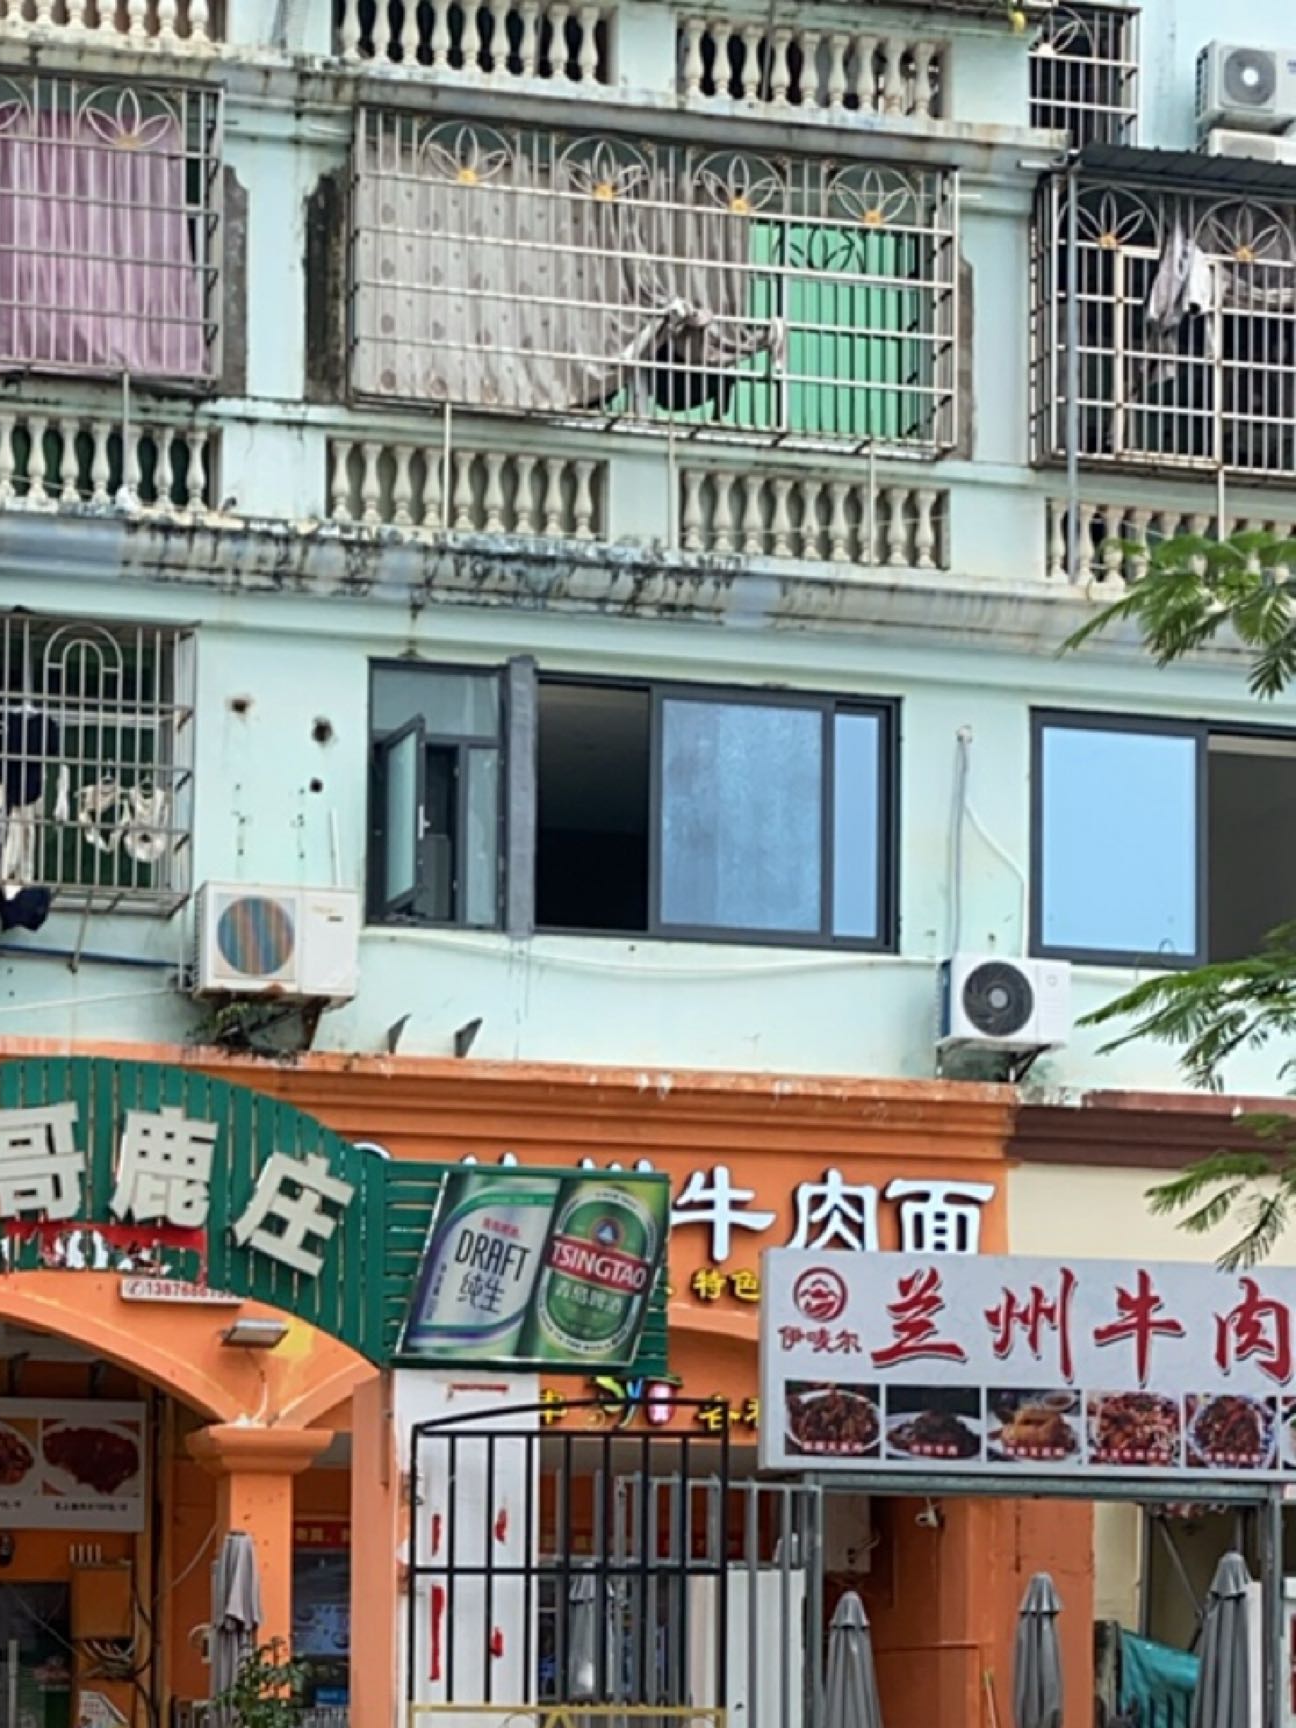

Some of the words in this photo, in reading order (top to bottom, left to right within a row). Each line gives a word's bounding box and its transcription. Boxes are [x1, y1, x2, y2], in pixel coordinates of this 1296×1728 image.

[454, 1228, 532, 1282] DRAFT
[551, 1240, 647, 1289] TSINGTAO
[455, 1270, 506, 1314] 纯生
[693, 1268, 761, 1303] 特色
[871, 1266, 1294, 1387] 兰州牛肉
